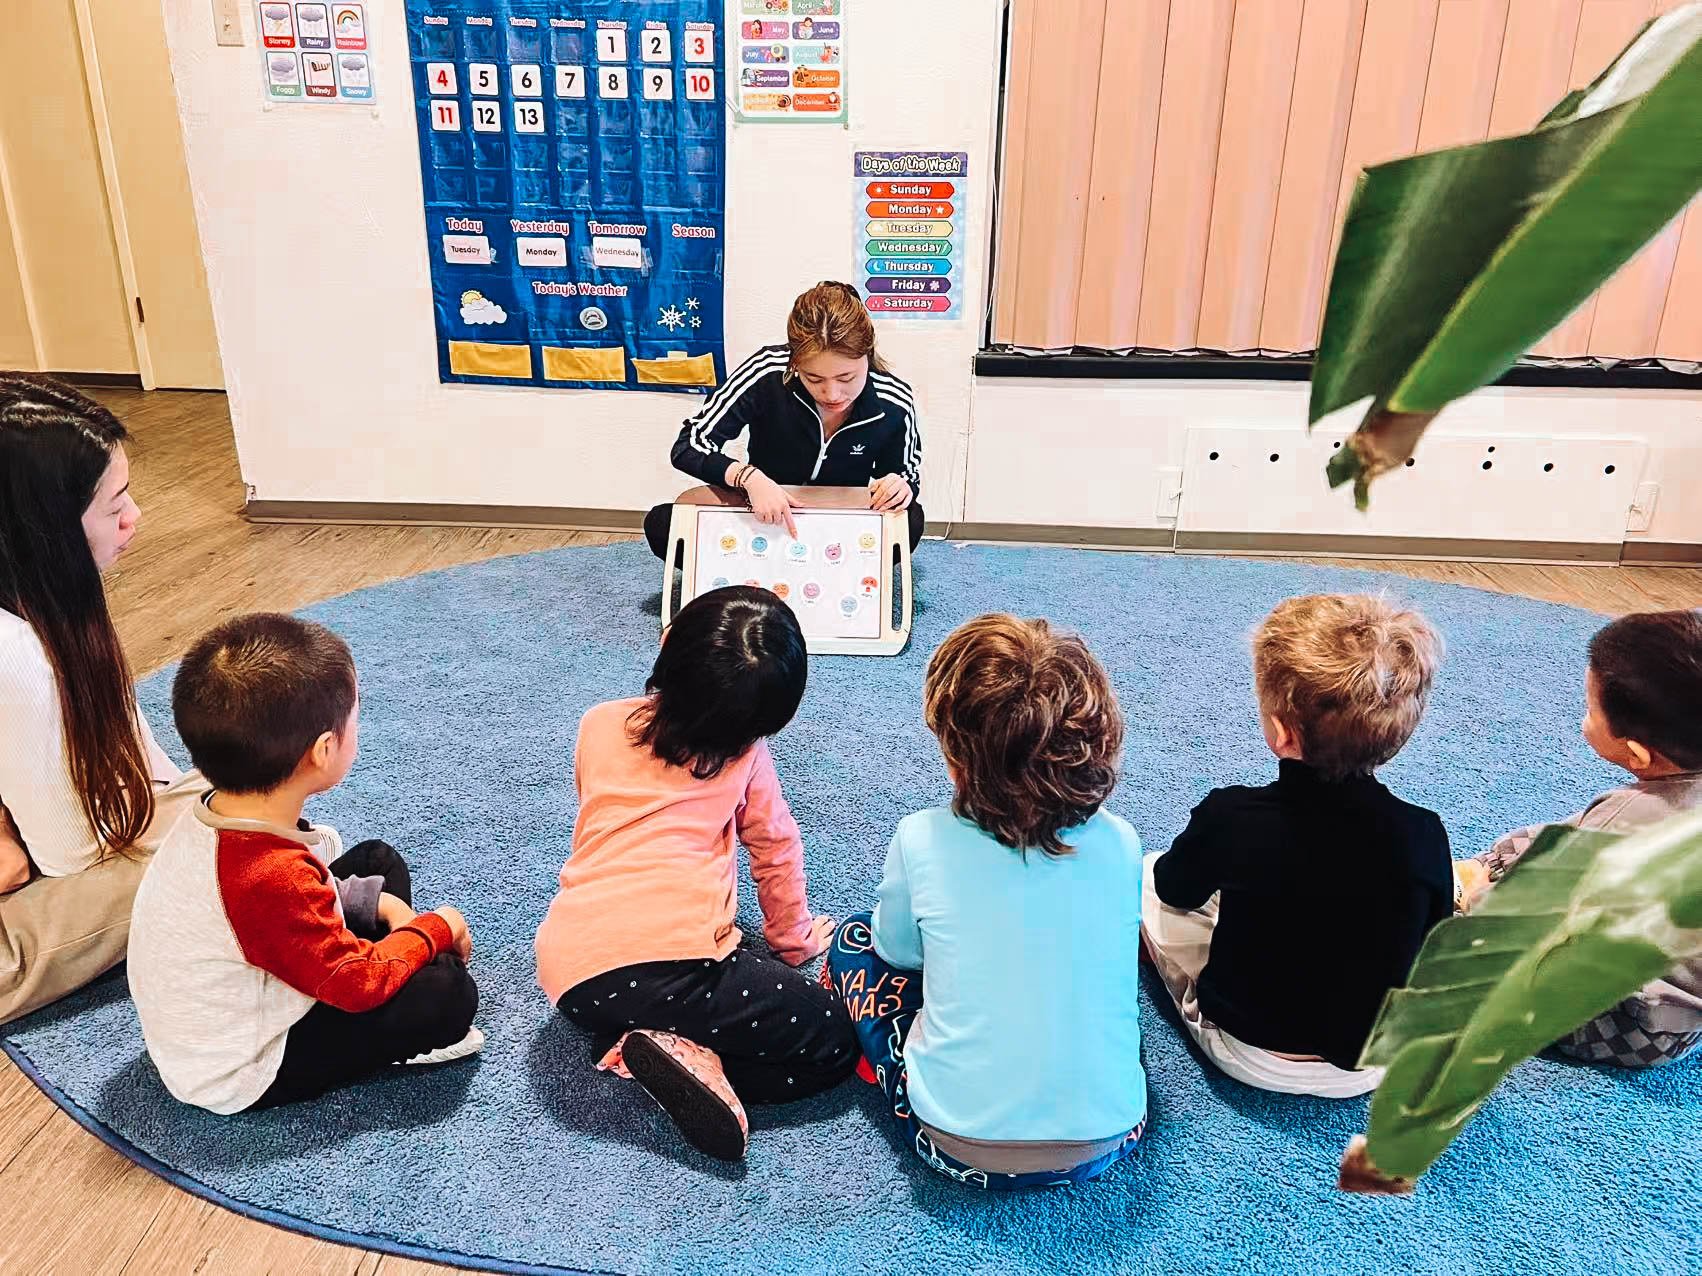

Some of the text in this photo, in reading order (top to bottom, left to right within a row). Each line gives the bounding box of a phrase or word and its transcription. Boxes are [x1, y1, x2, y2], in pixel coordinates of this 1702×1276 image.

[424, 17, 448, 25] Sunday
[511, 18, 536, 26] Tuesday
[647, 21, 666, 29] Friday
[687, 22, 714, 31] Saturday
[268, 37, 291, 46] Stormy
[306, 39, 324, 47] Rainy
[608, 36, 705, 55] 1 2 3
[745, 51, 759, 59] July
[437, 71, 710, 92] 4 5 6 7 8 9 10
[757, 75, 788, 83] September
[276, 86, 295, 95] Foggy
[311, 86, 331, 95] Windy
[345, 87, 367, 96] Snowy
[438, 107, 539, 125] 11 12 13
[863, 156, 960, 173] Days of the Week
[890, 184, 932, 195] Sunday
[888, 204, 932, 215] Monday
[446, 217, 715, 238] Today Yesterday Tomorrow Season
[887, 223, 933, 235] Tuesday
[451, 245, 481, 254] Tuesday
[526, 248, 557, 257] Monday
[595, 247, 639, 258] Wednesday
[878, 242, 943, 253] Wednesday
[884, 261, 934, 272] Thursday
[533, 282, 628, 296] Today's Weather
[892, 280, 926, 291] Friday
[884, 298, 933, 309] Saturday
